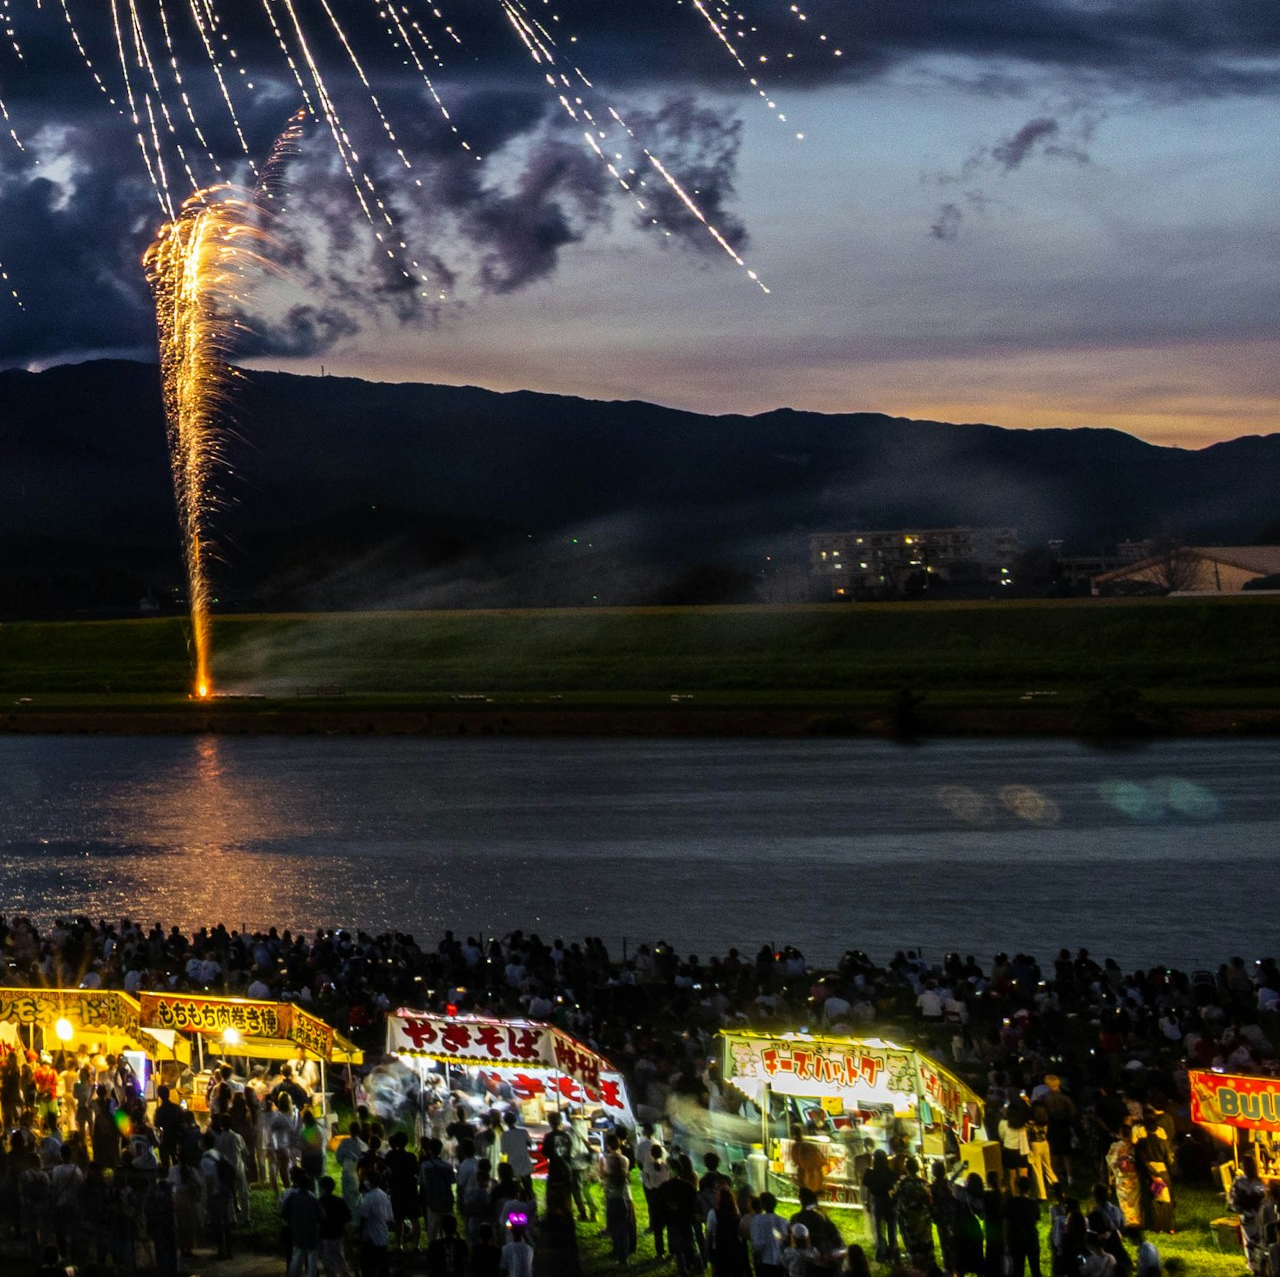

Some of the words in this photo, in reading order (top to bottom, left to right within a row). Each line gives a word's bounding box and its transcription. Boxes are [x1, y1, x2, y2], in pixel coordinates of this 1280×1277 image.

[157, 1000, 280, 1035] もちもち肉巻き棒
[402, 1018, 544, 1060] やきそば
[762, 1048, 884, 1088] チーズハットグ
